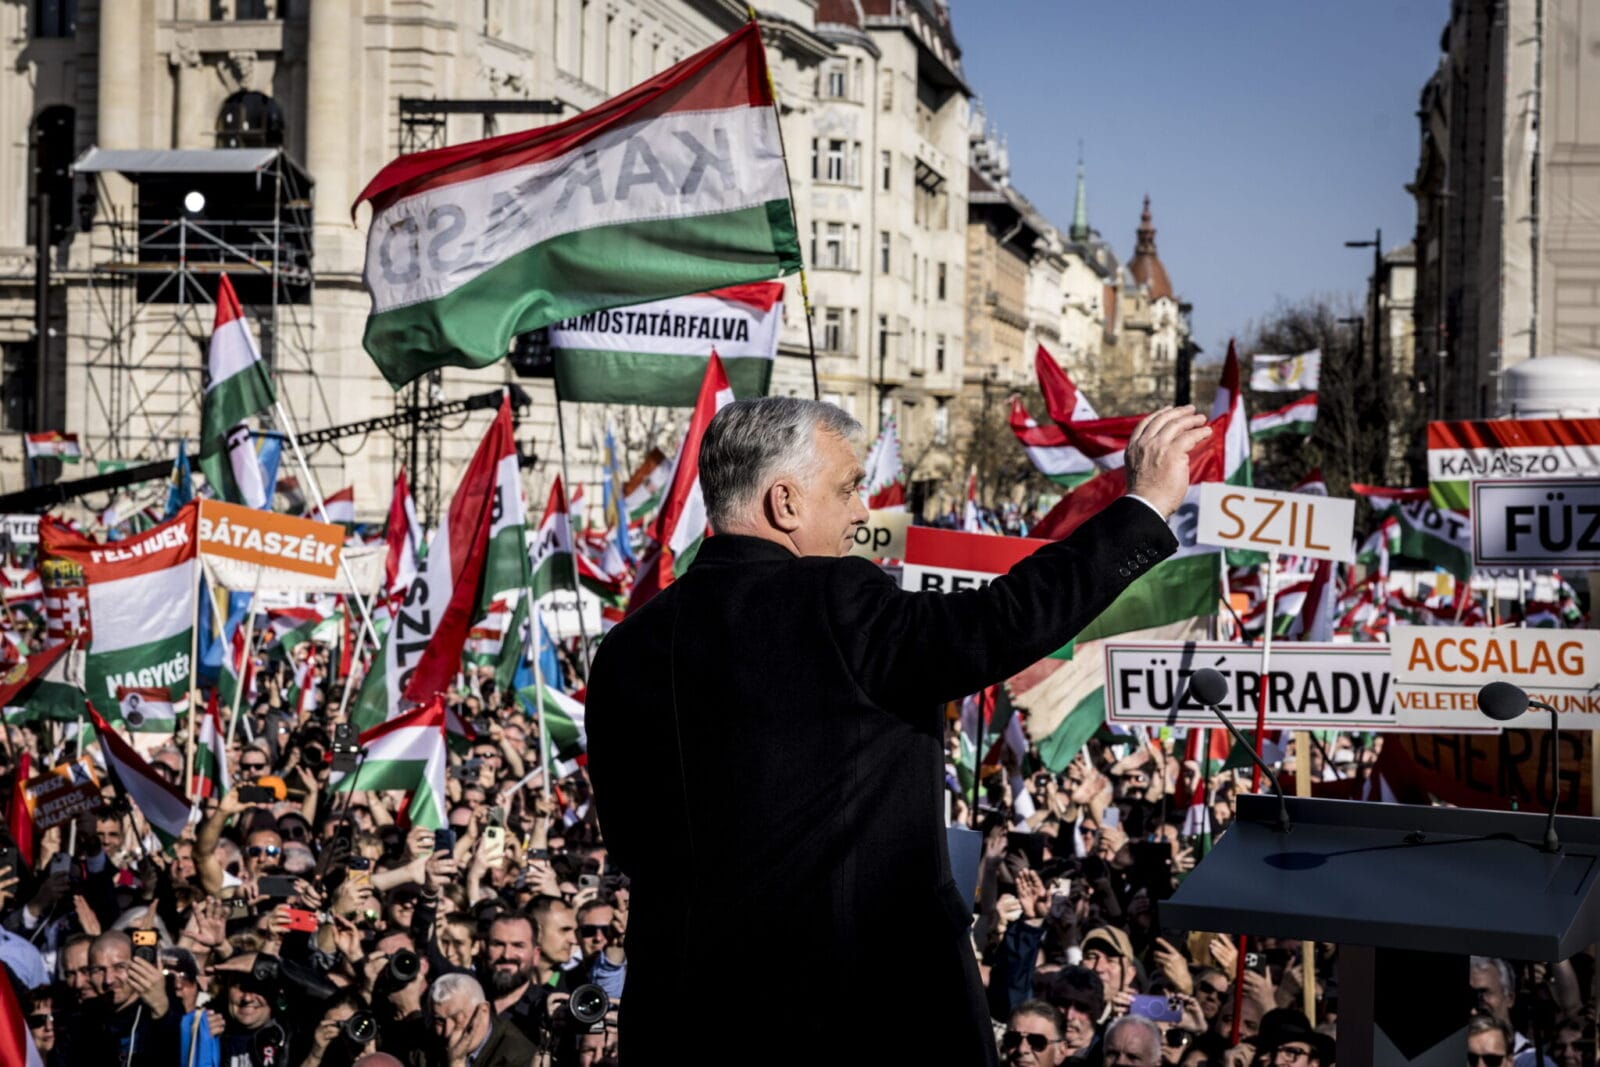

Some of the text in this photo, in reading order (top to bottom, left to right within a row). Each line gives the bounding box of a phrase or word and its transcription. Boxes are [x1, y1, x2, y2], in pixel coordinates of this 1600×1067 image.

[198, 516, 337, 566] BÁTASZÉK
[1217, 493, 1331, 551] SZIL
[1407, 637, 1585, 676] ACSALAG
[1119, 655, 1398, 716] FÜZÉRRADV
[1395, 691, 1478, 711] VELETE
